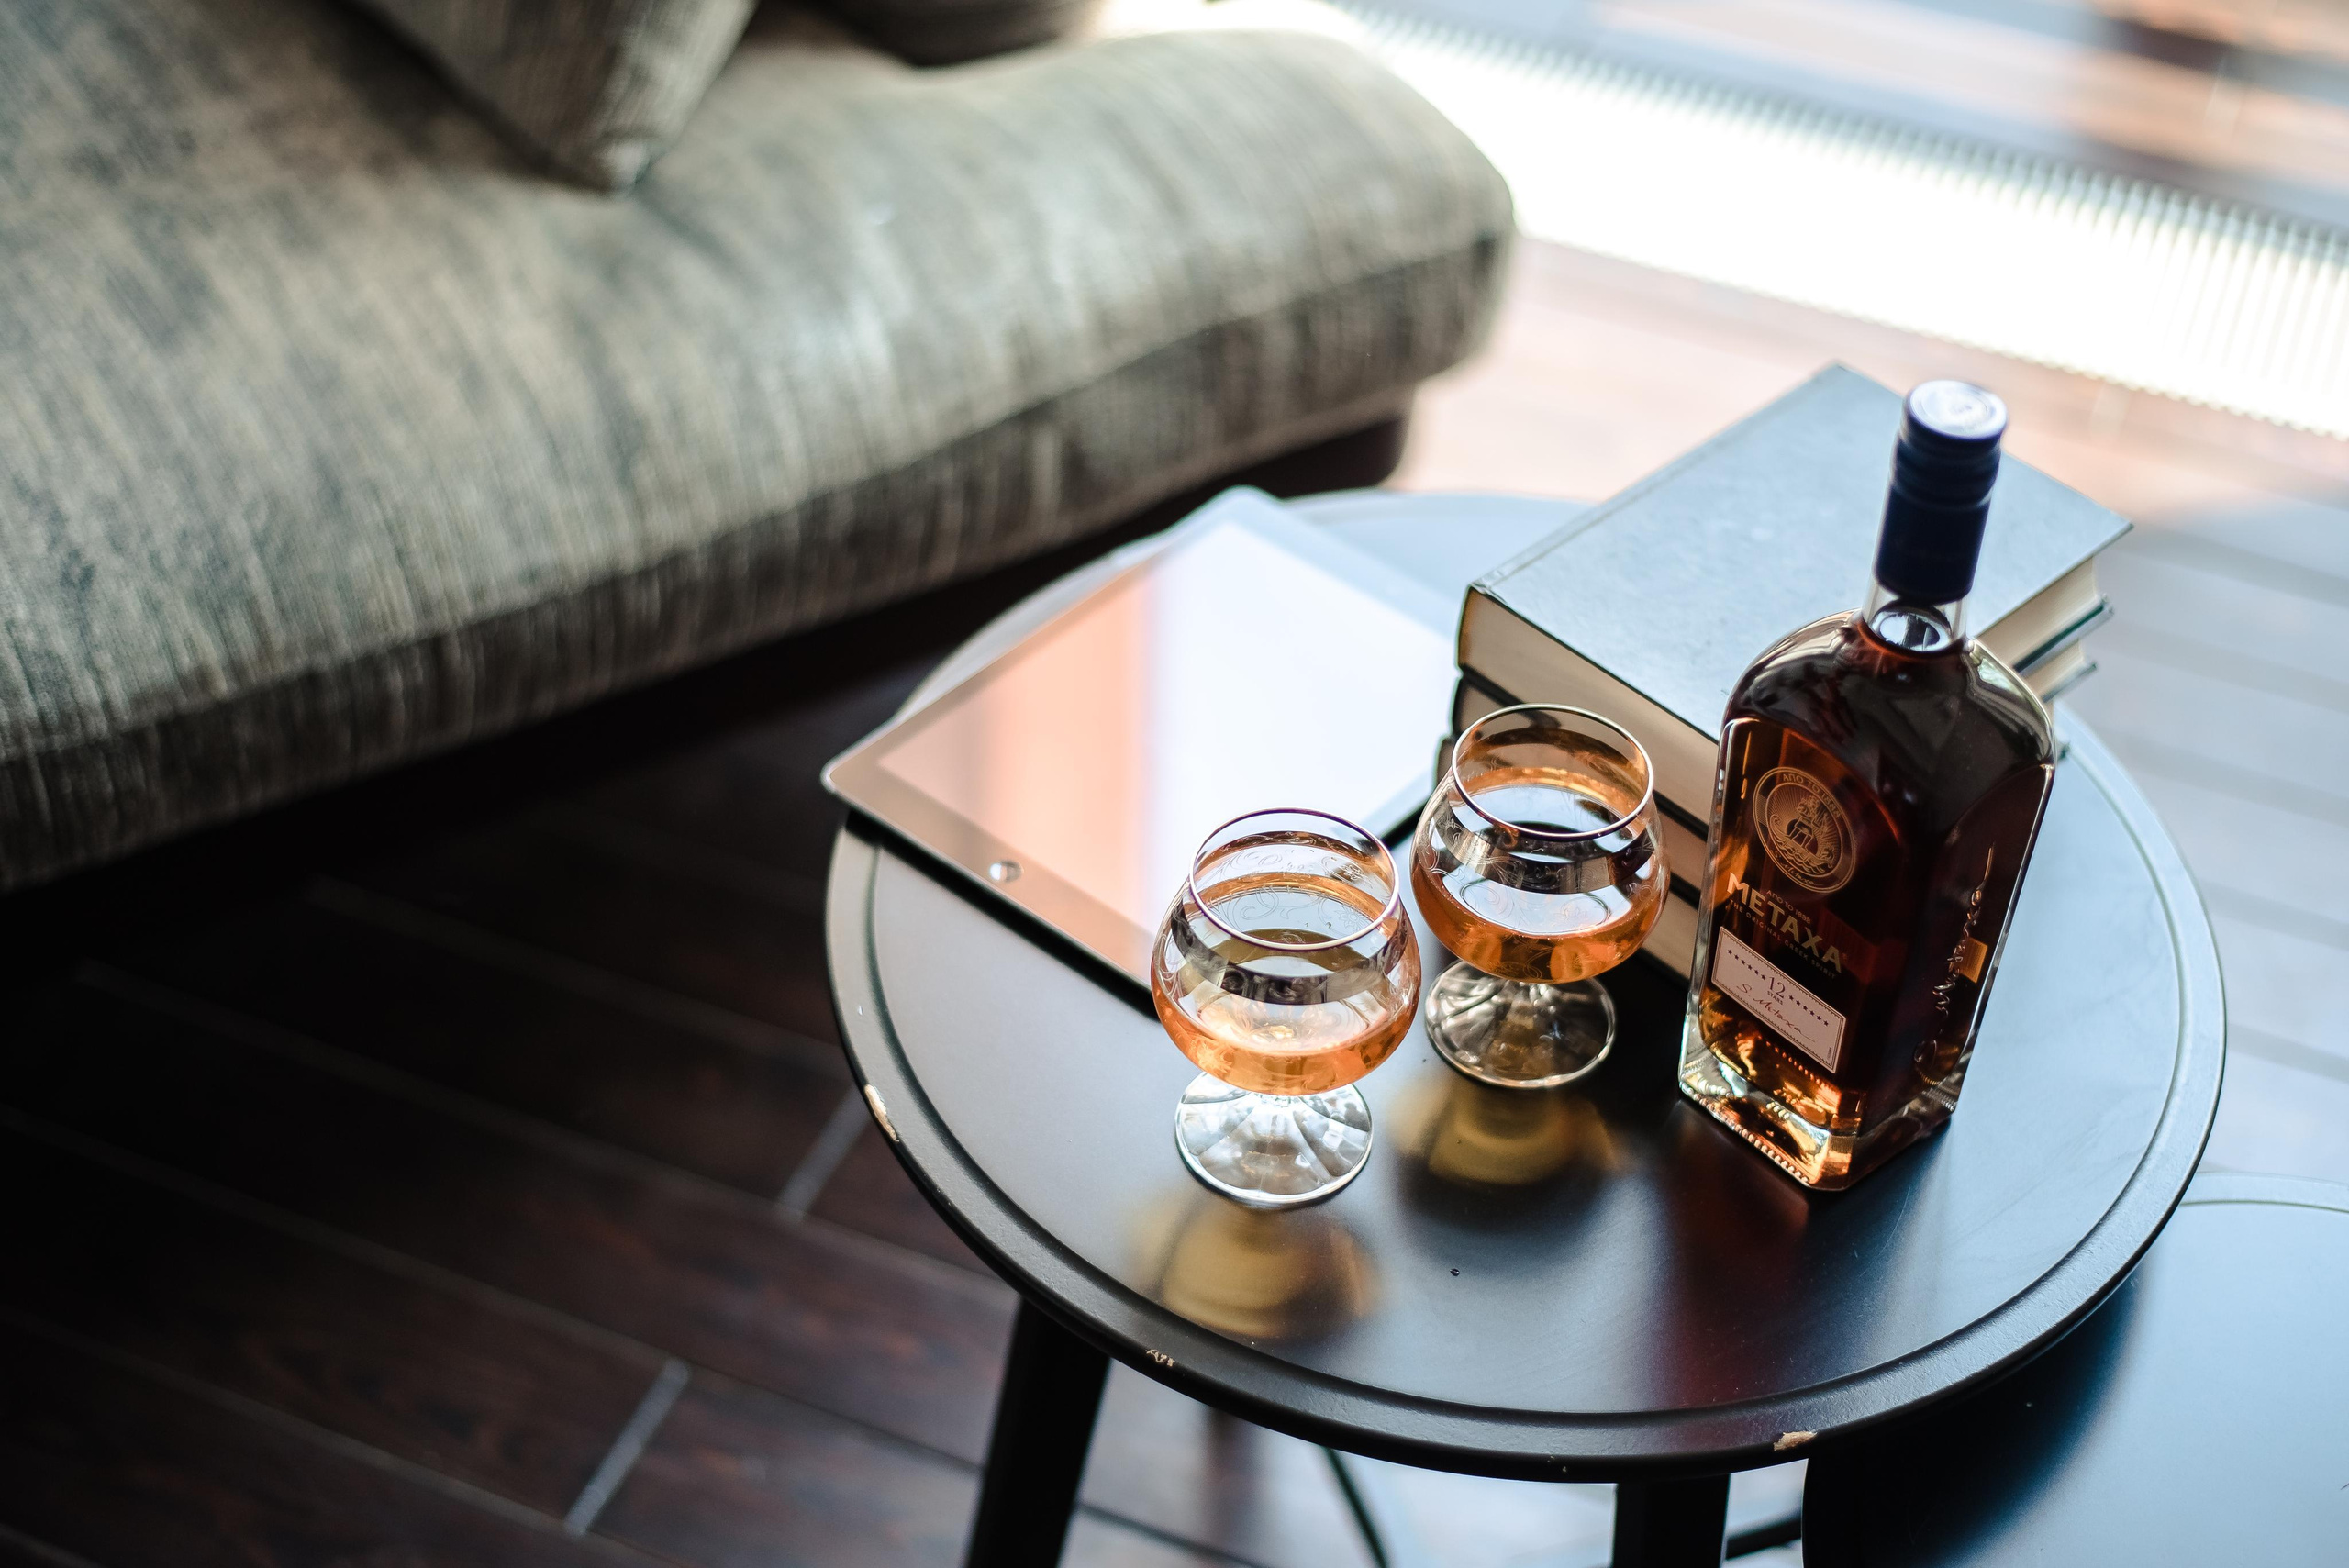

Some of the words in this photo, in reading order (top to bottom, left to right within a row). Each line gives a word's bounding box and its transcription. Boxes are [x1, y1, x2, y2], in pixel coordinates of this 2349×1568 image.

[1727, 872, 1842, 973] METAXA
[1795, 909, 1812, 925] 1888
[1729, 899, 1744, 914] THE
[1746, 911, 1782, 941] ORIGINAL
[1784, 940, 1809, 961] GREEK
[1811, 959, 1836, 980] SPIRIT
[1766, 990, 1784, 1006] STARS
[1769, 976, 1786, 999] 12
[1753, 997, 1815, 1043] Metaxa
